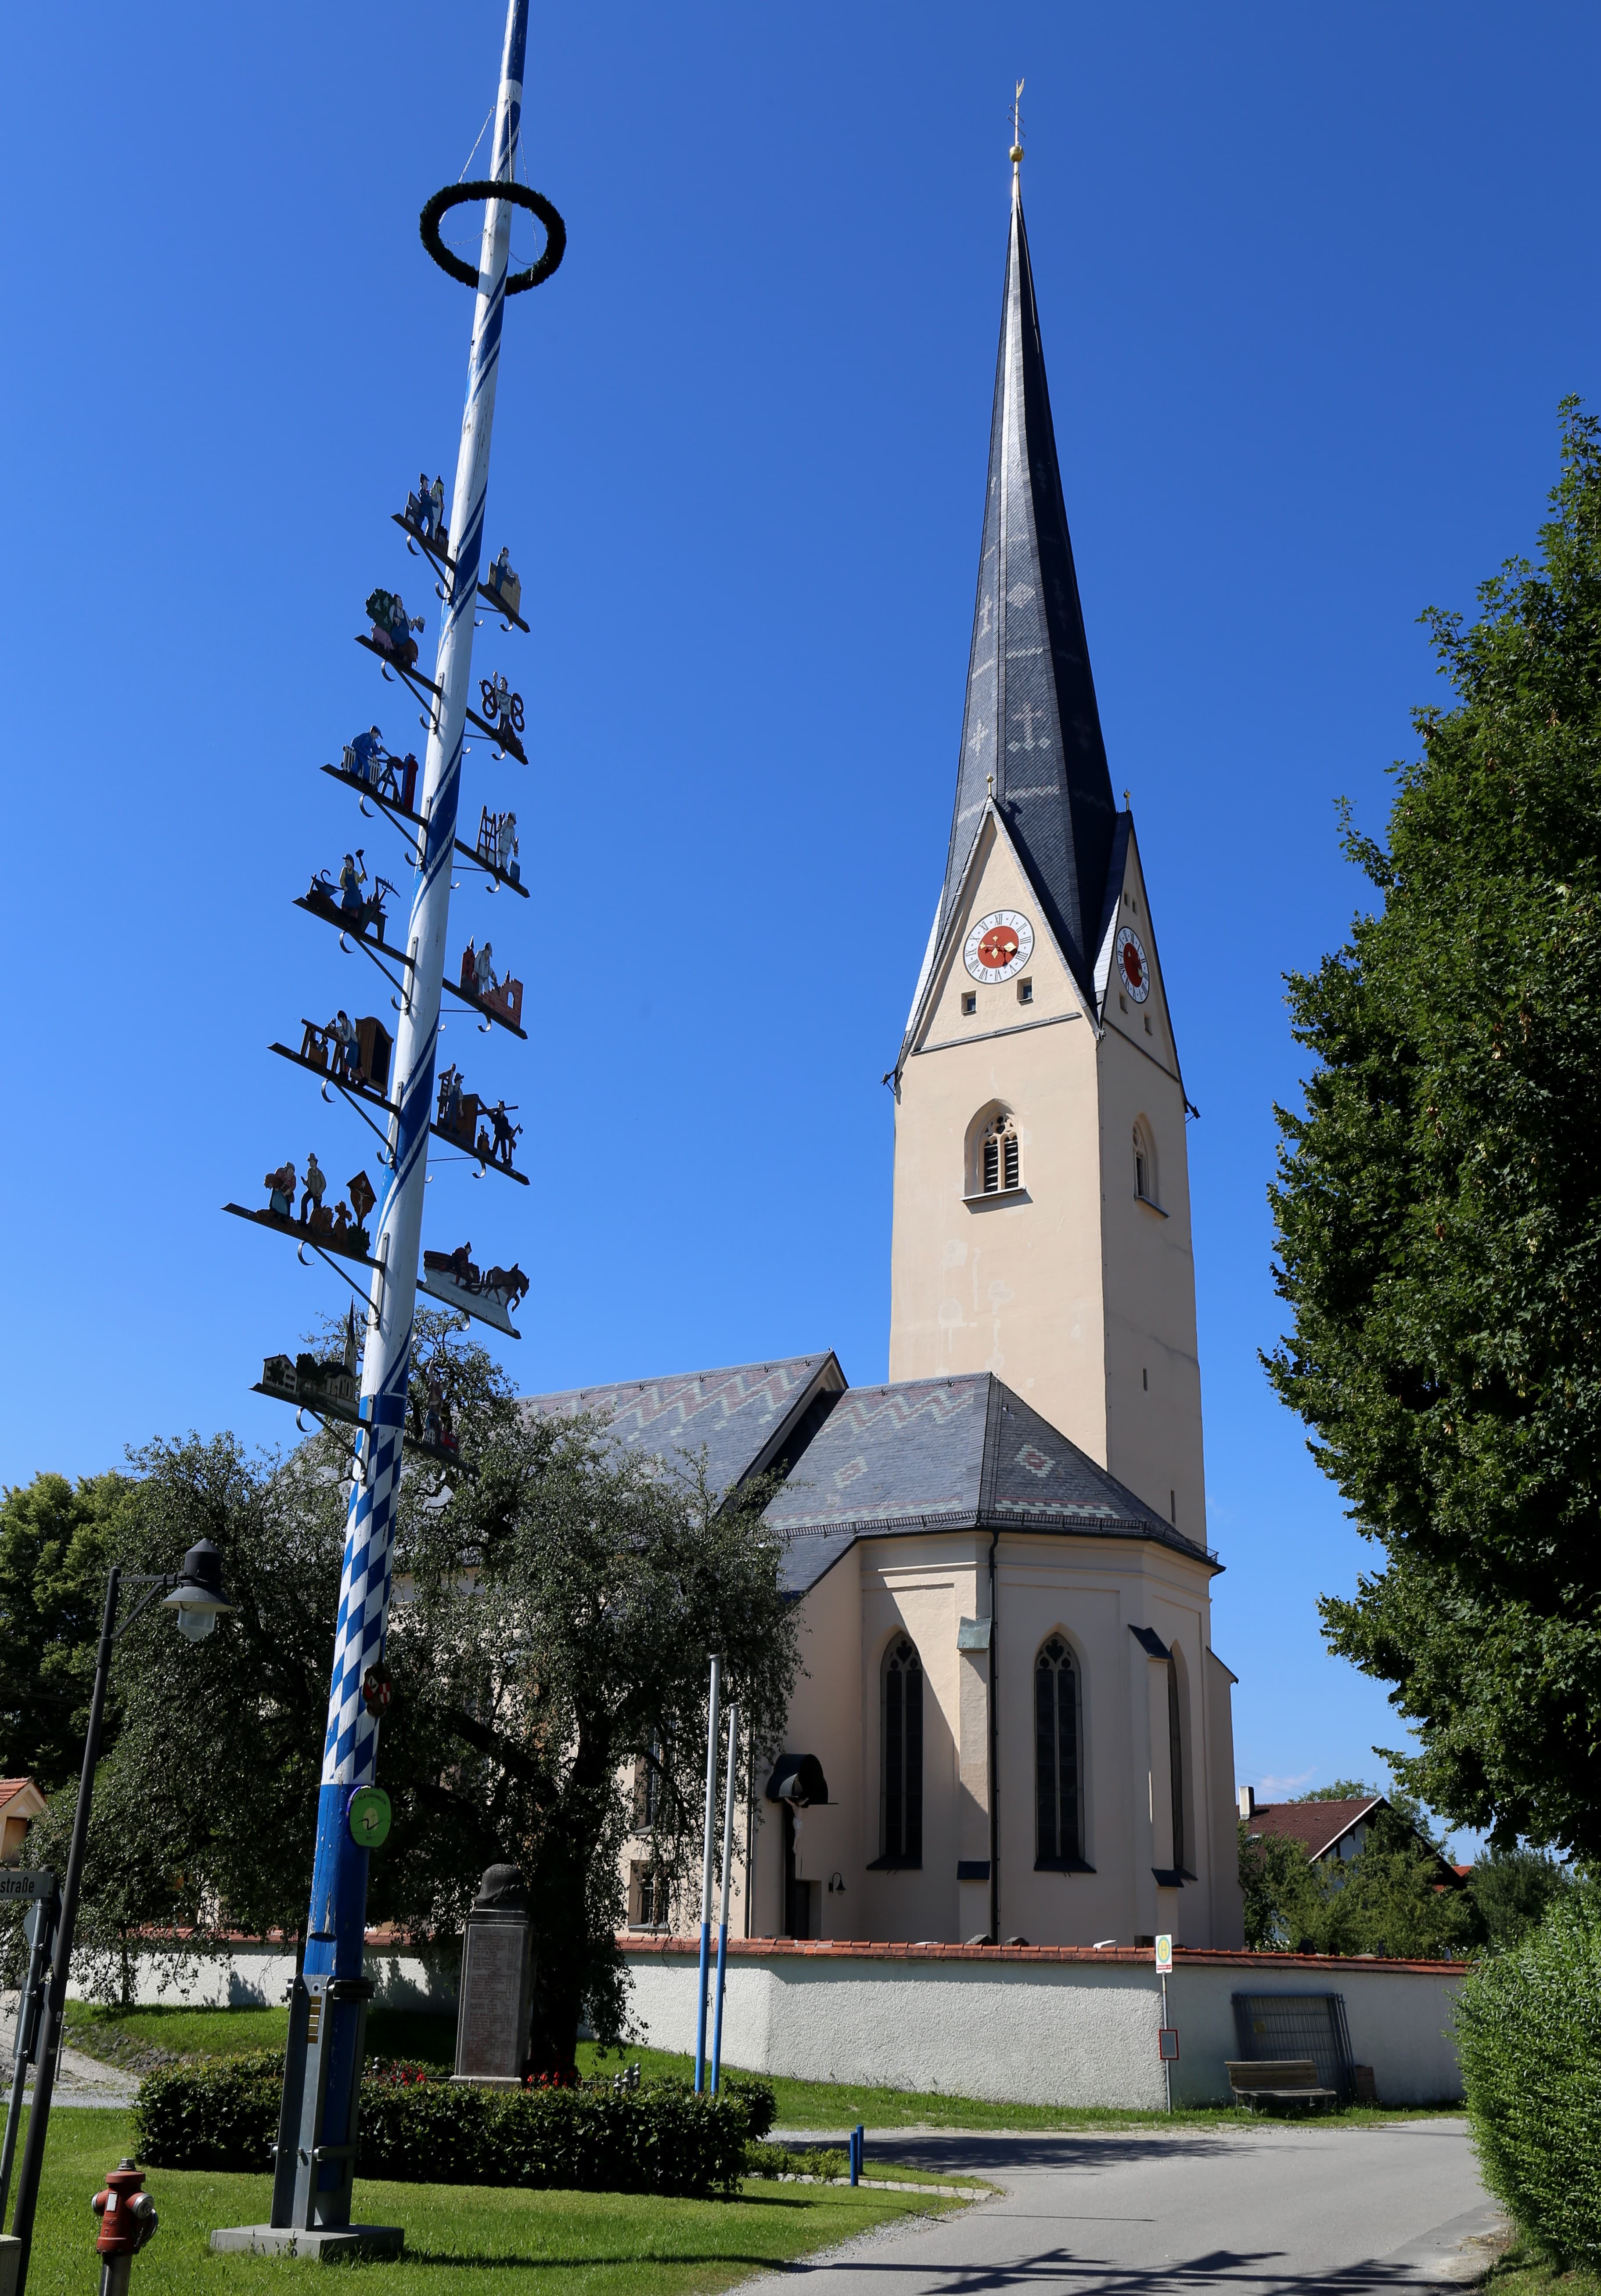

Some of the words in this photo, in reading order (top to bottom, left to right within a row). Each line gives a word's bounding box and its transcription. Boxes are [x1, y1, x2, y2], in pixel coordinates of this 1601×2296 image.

[994, 913, 1003, 926] XII
[1009, 915, 1016, 926] I
[979, 921, 989, 933] XI
[1016, 923, 1027, 933] II
[1020, 936, 1031, 944] III
[965, 948, 977, 957] IX
[968, 959, 979, 973] VIII
[1009, 964, 1017, 974] V
[979, 968, 988, 981] VII
[994, 969, 1002, 981] VI
[0, 1876, 35, 1893] straße
[1161, 1942, 1167, 1957] H
